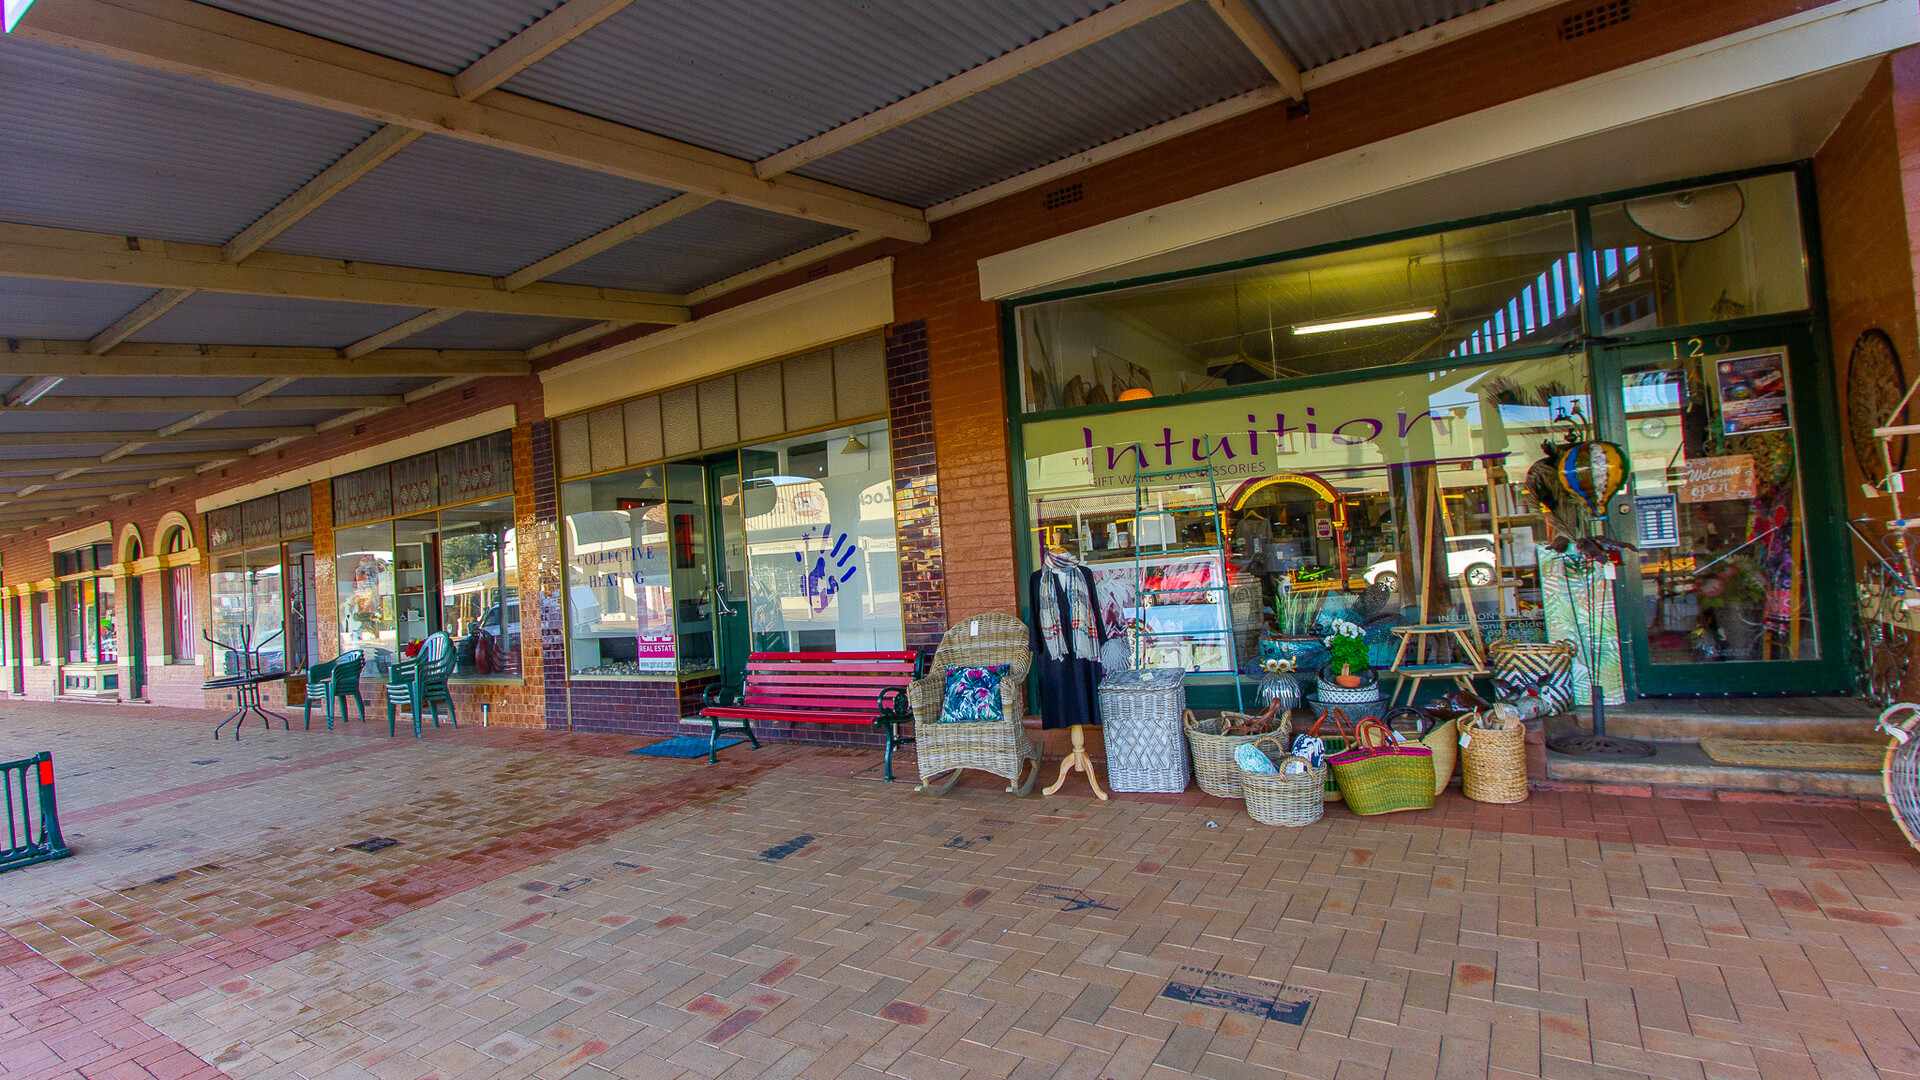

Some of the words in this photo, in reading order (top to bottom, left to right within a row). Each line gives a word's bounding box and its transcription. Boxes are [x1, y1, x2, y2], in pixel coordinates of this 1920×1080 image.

[1671, 335, 1730, 359] 129
[1083, 407, 1450, 474] Intuition
[1089, 476, 1115, 488] GIFT
[1164, 470, 1175, 481] &
[1686, 466, 1741, 482] Welcome
[577, 545, 654, 567] COLLECTIVE
[654, 644, 675, 652] ESTATE
